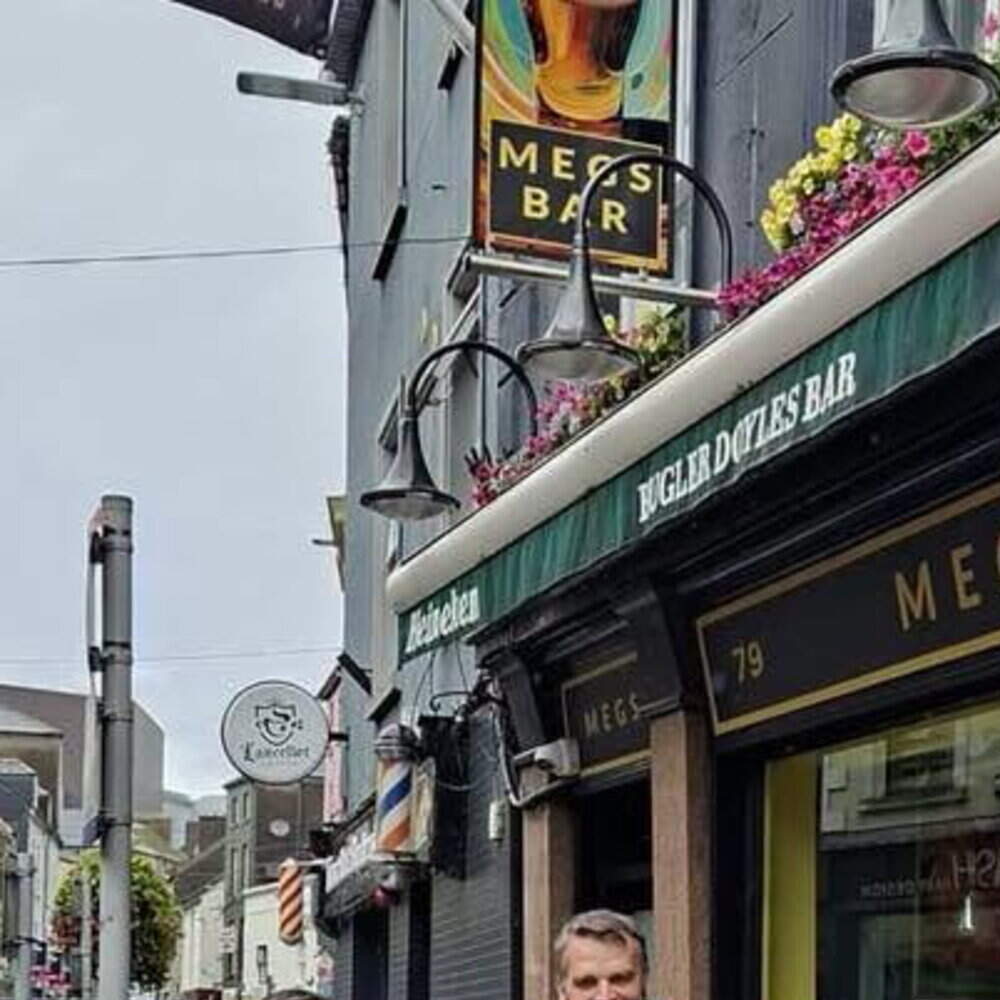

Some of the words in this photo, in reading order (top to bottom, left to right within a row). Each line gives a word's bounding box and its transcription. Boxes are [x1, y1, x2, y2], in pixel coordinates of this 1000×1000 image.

[522, 185, 629, 234] BAR
[801, 351, 857, 423] BAR
[730, 640, 765, 684] 79
